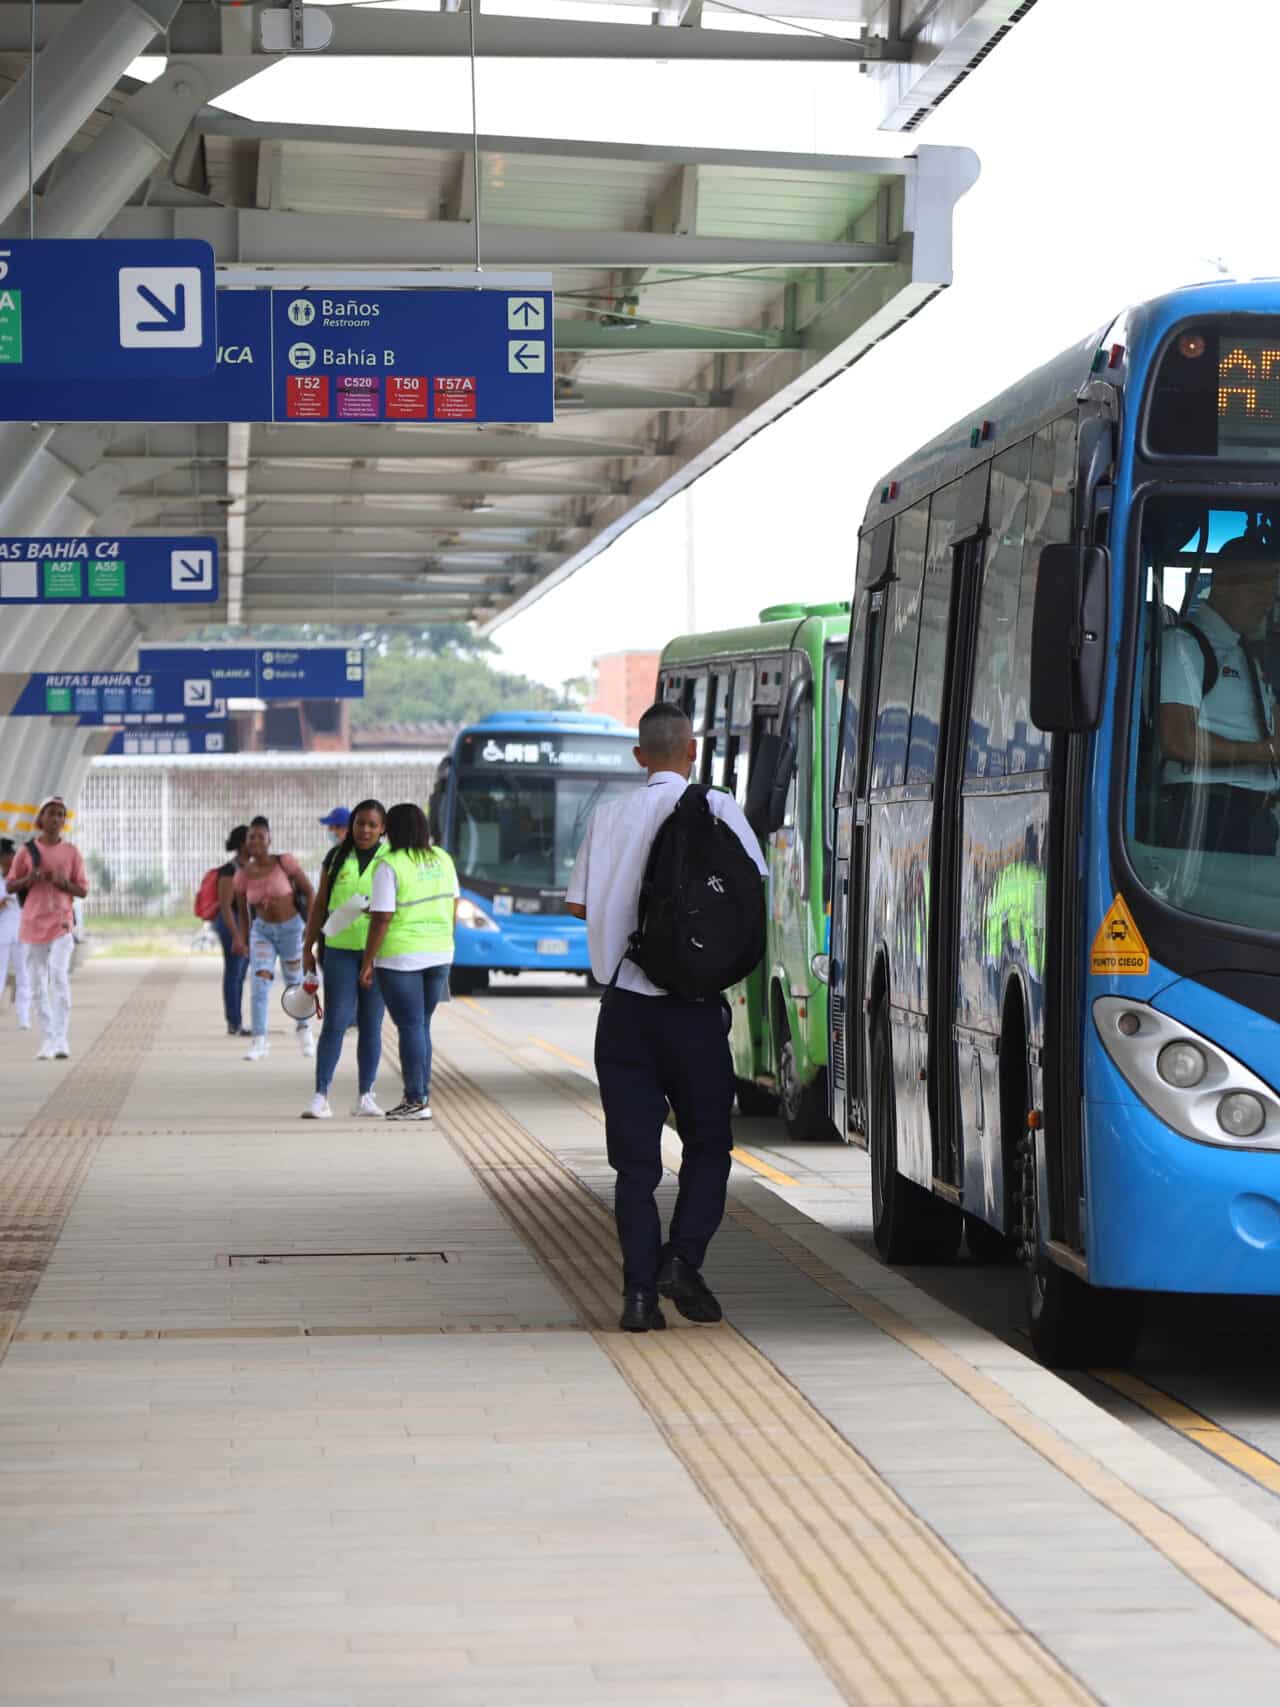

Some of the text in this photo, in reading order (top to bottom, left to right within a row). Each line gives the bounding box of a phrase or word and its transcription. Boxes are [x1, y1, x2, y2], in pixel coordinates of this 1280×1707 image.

[322, 299, 381, 316] Baños
[322, 318, 371, 328] Restroom
[322, 348, 395, 366] Bahía B
[295, 377, 321, 389] T52
[344, 377, 372, 387] C520
[393, 378, 419, 389] T50
[436, 378, 473, 390] T57A
[27, 538, 89, 558] BAHÍA
[95, 542, 119, 558] C4
[46, 675, 88, 687] RUTAS
[91, 673, 132, 687] BAHÍA
[1093, 957, 1144, 967] PUNTO CIEGO
